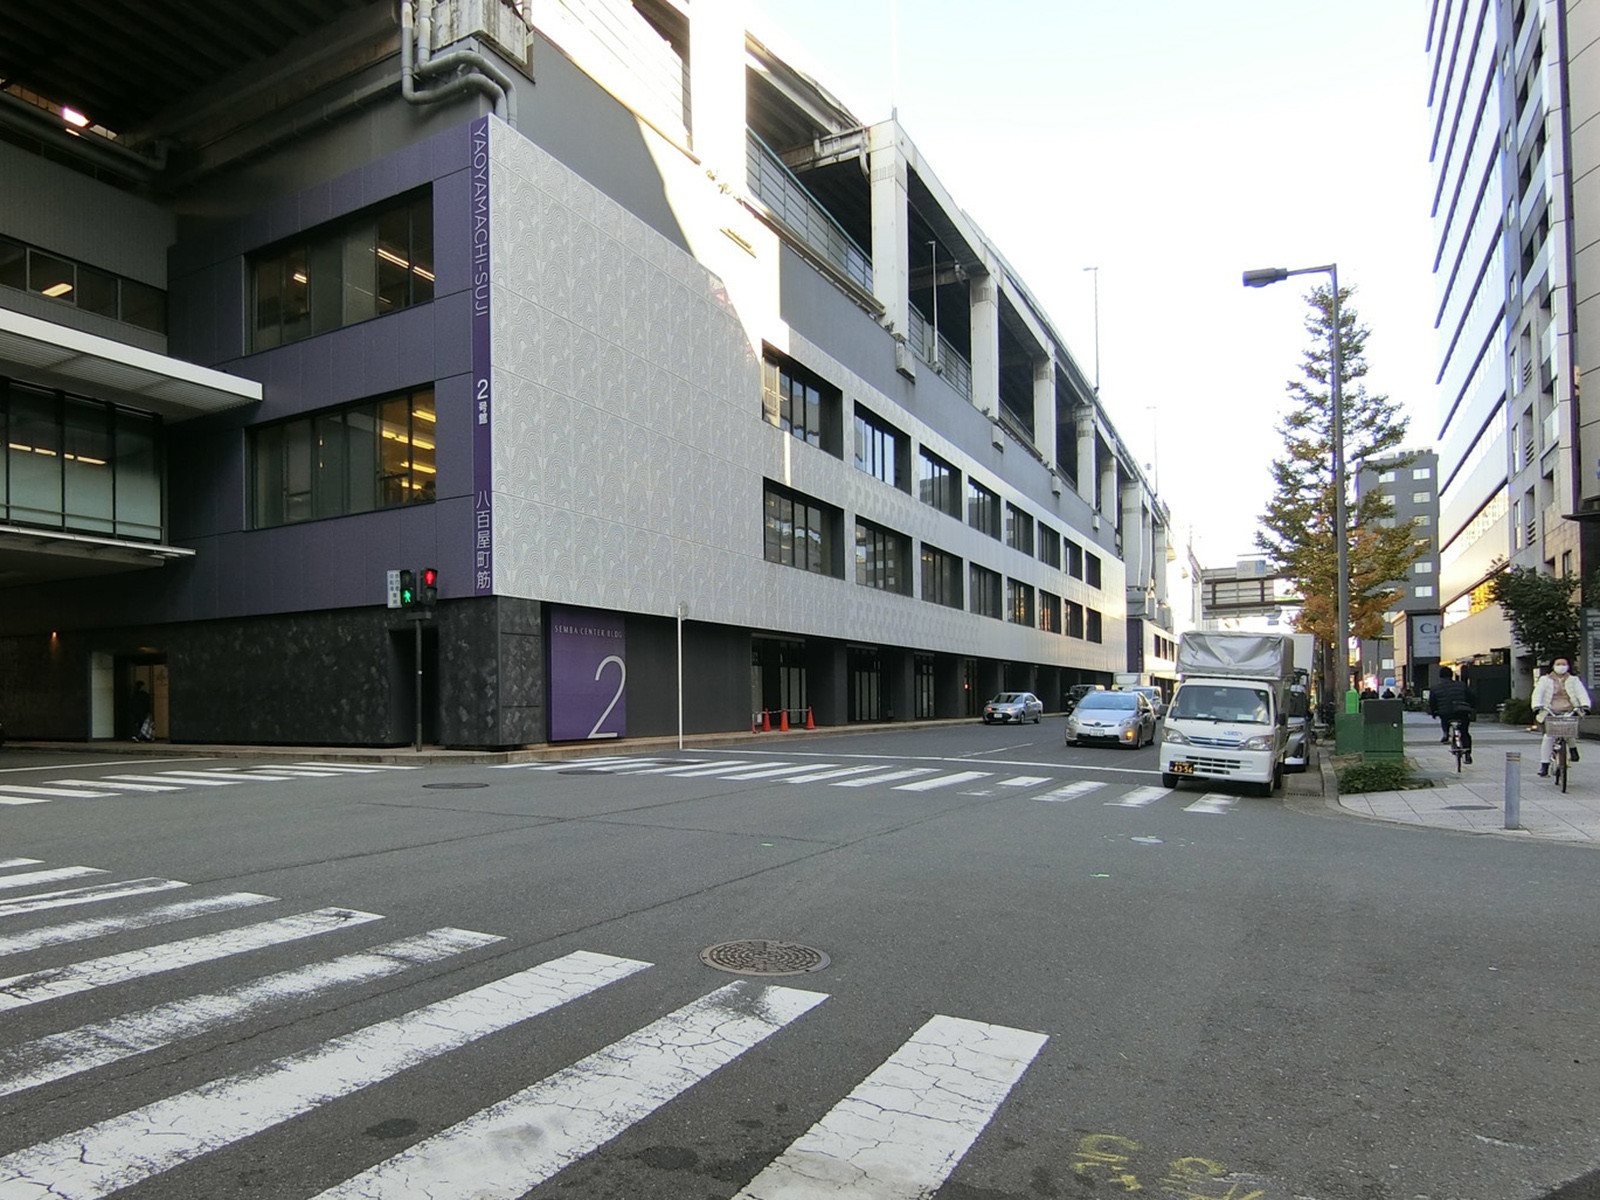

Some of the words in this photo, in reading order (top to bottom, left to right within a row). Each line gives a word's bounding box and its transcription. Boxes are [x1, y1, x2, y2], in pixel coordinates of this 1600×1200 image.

[474, 123, 488, 317] YAOYAMACHI-SUJI
[476, 490, 491, 589] 八百屋町筋
[554, 624, 578, 635] SEMBA
[580, 627, 605, 637] CENTER
[587, 655, 626, 739] 2
